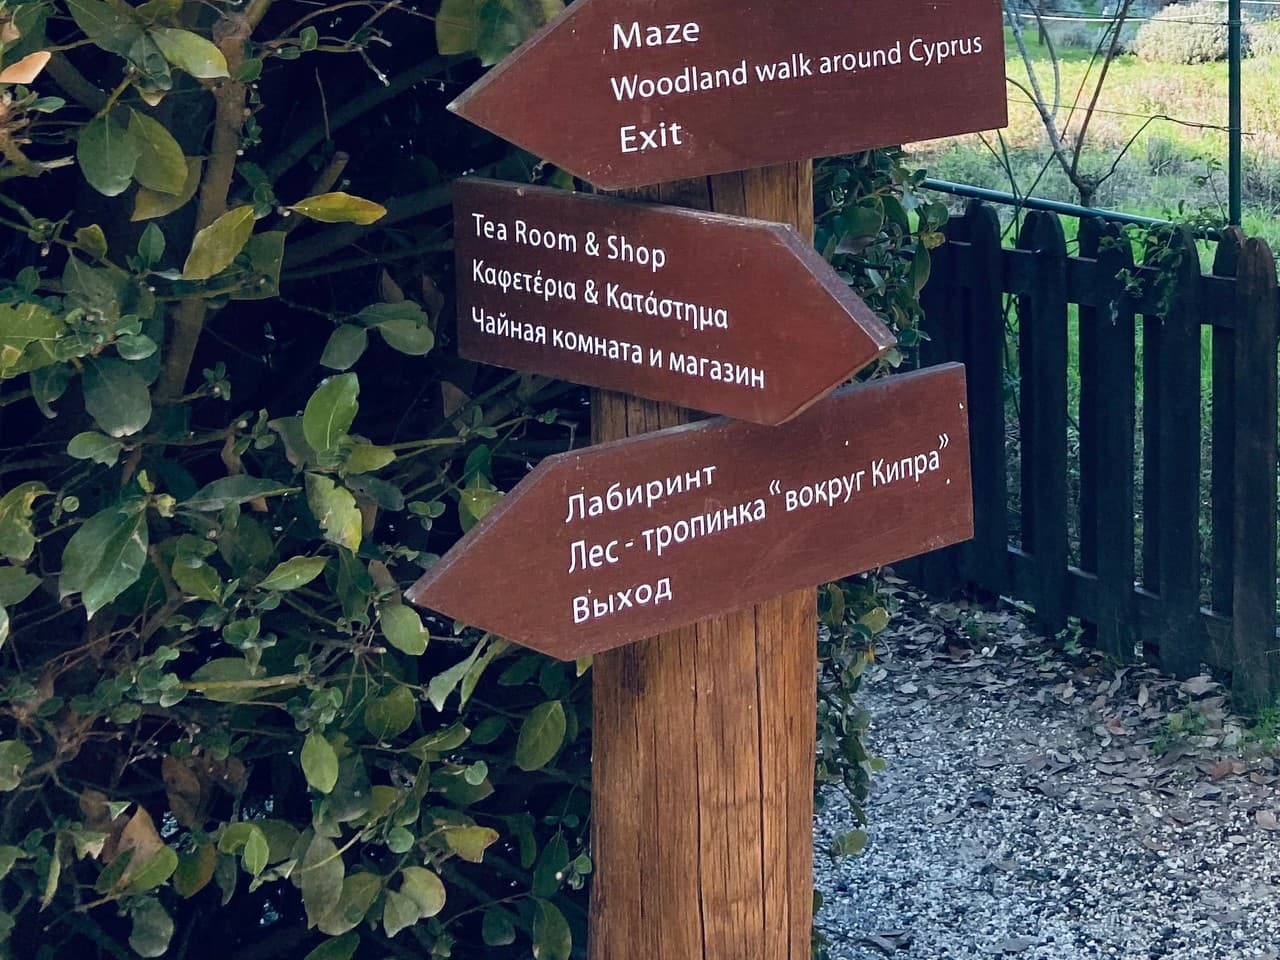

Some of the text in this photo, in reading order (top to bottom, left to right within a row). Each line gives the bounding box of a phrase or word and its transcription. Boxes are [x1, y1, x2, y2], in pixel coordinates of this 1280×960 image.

[612, 20, 700, 51] Maze
[610, 32, 984, 102] Woodland walk around Cyprus
[619, 120, 683, 154] Exit
[471, 212, 666, 273] Tea Room & Shop
[472, 258, 729, 331] Καφετέρια & Κατάστημα
[471, 306, 765, 389] Чайная комната и магазин
[565, 465, 717, 523] Лабиринт
[567, 539, 619, 574] Лес
[641, 496, 767, 555] тропинка
[572, 577, 672, 624] Выход
